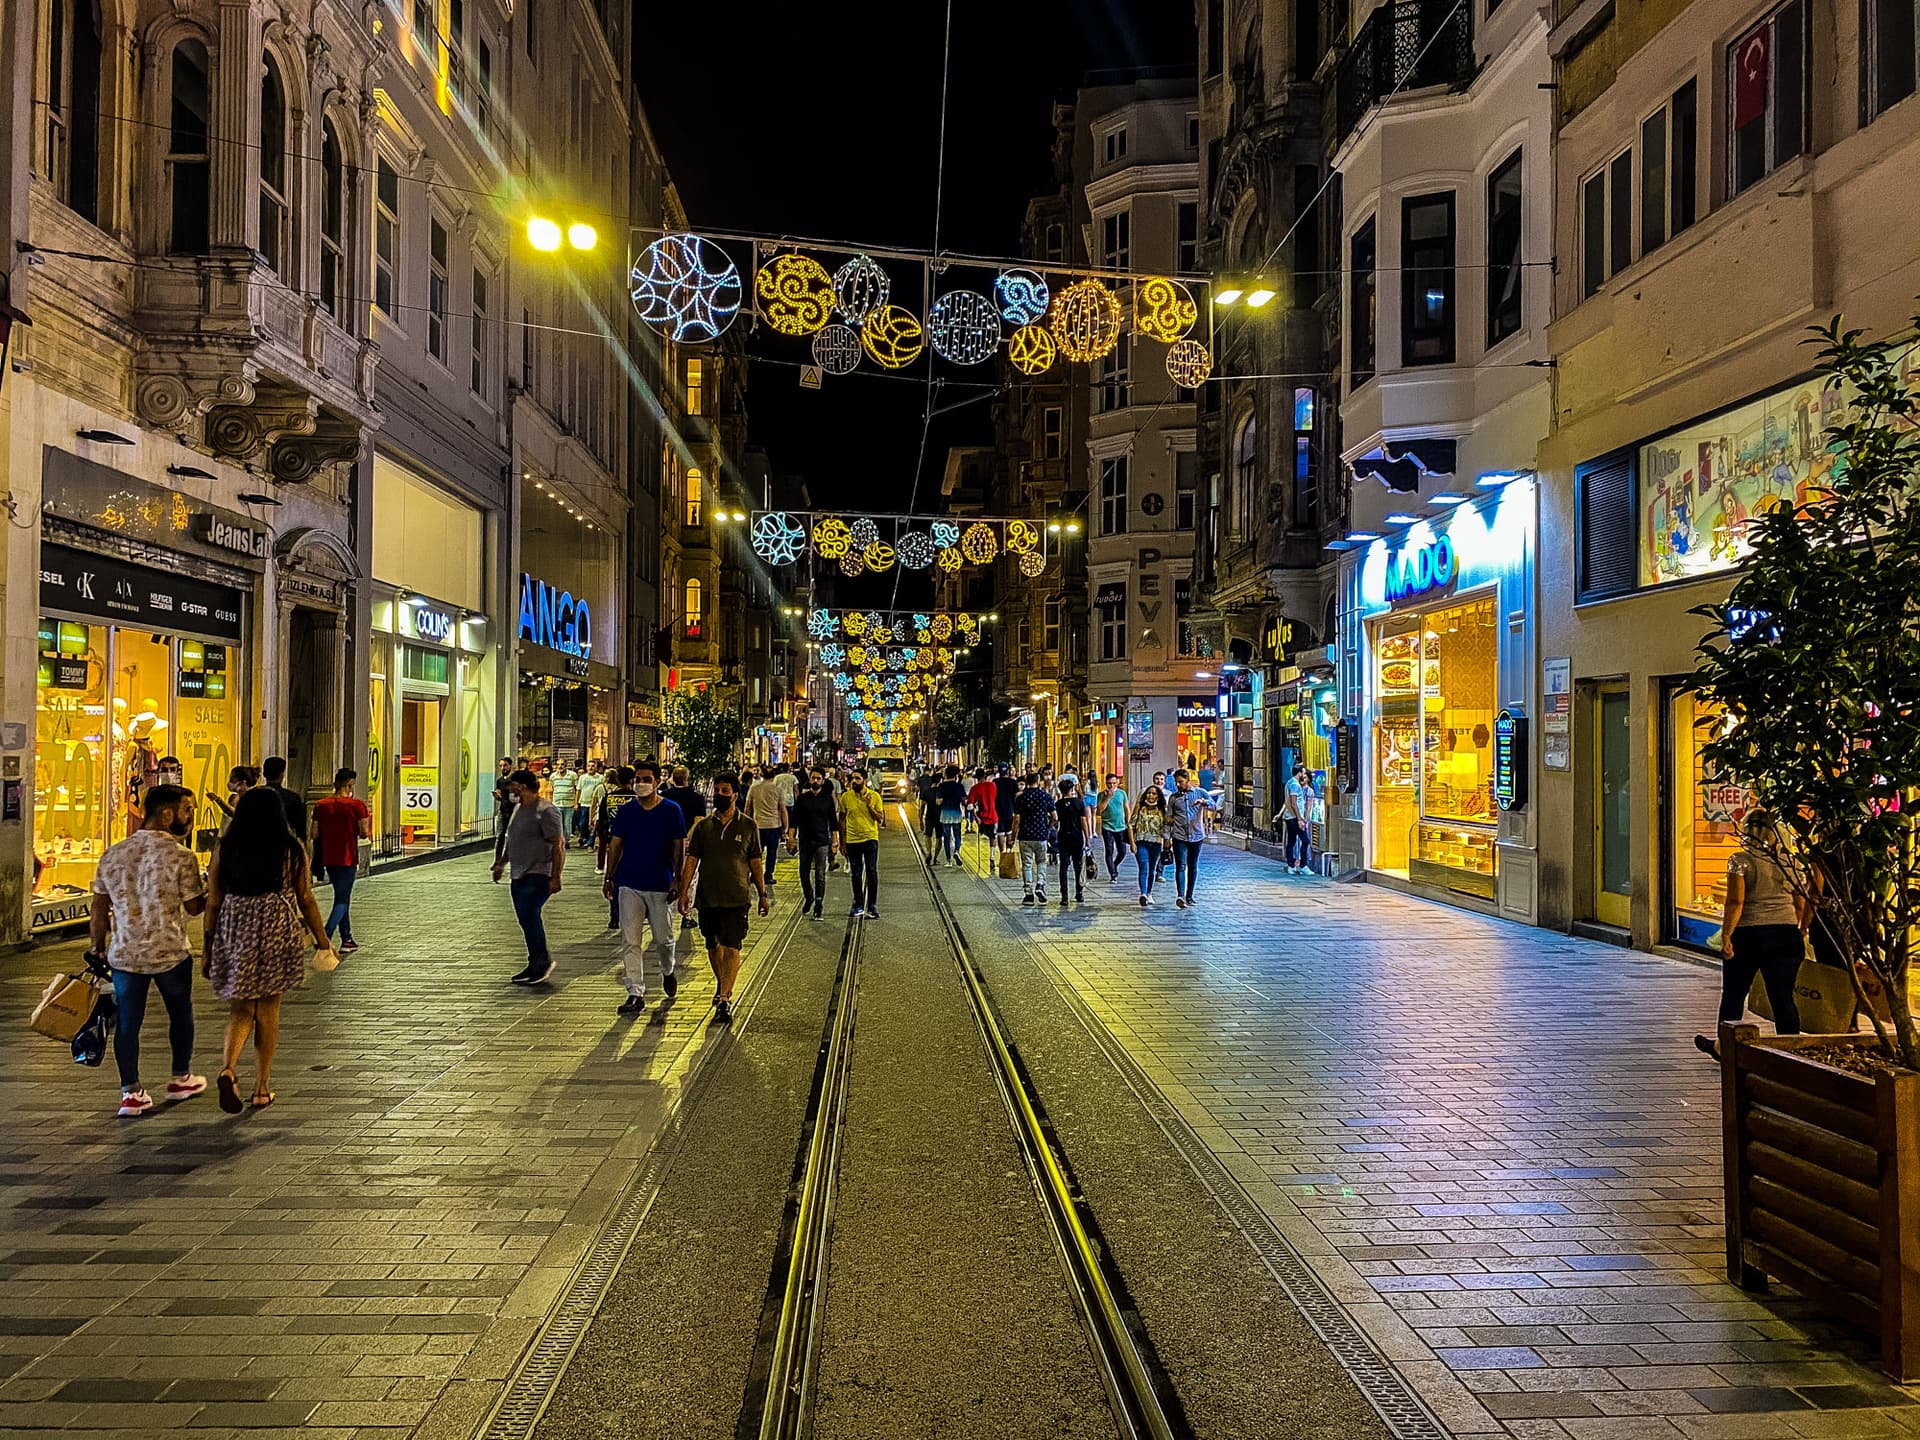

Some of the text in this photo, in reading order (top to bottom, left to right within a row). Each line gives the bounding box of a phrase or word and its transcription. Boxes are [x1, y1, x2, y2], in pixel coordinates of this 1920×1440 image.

[1385, 534, 1454, 602] MADO
[1094, 593, 1123, 604] TUDORS
[180, 601, 208, 616] G-STAR
[214, 608, 237, 622] GUESS
[417, 609, 449, 639] COLIN'S
[1267, 617, 1292, 661] LUXUS
[60, 666, 86, 677] TOMMY
[194, 705, 225, 724] SALE
[1177, 707, 1216, 718] TUDORS
[406, 792, 433, 809] 30
[1710, 789, 1741, 805] FREE
